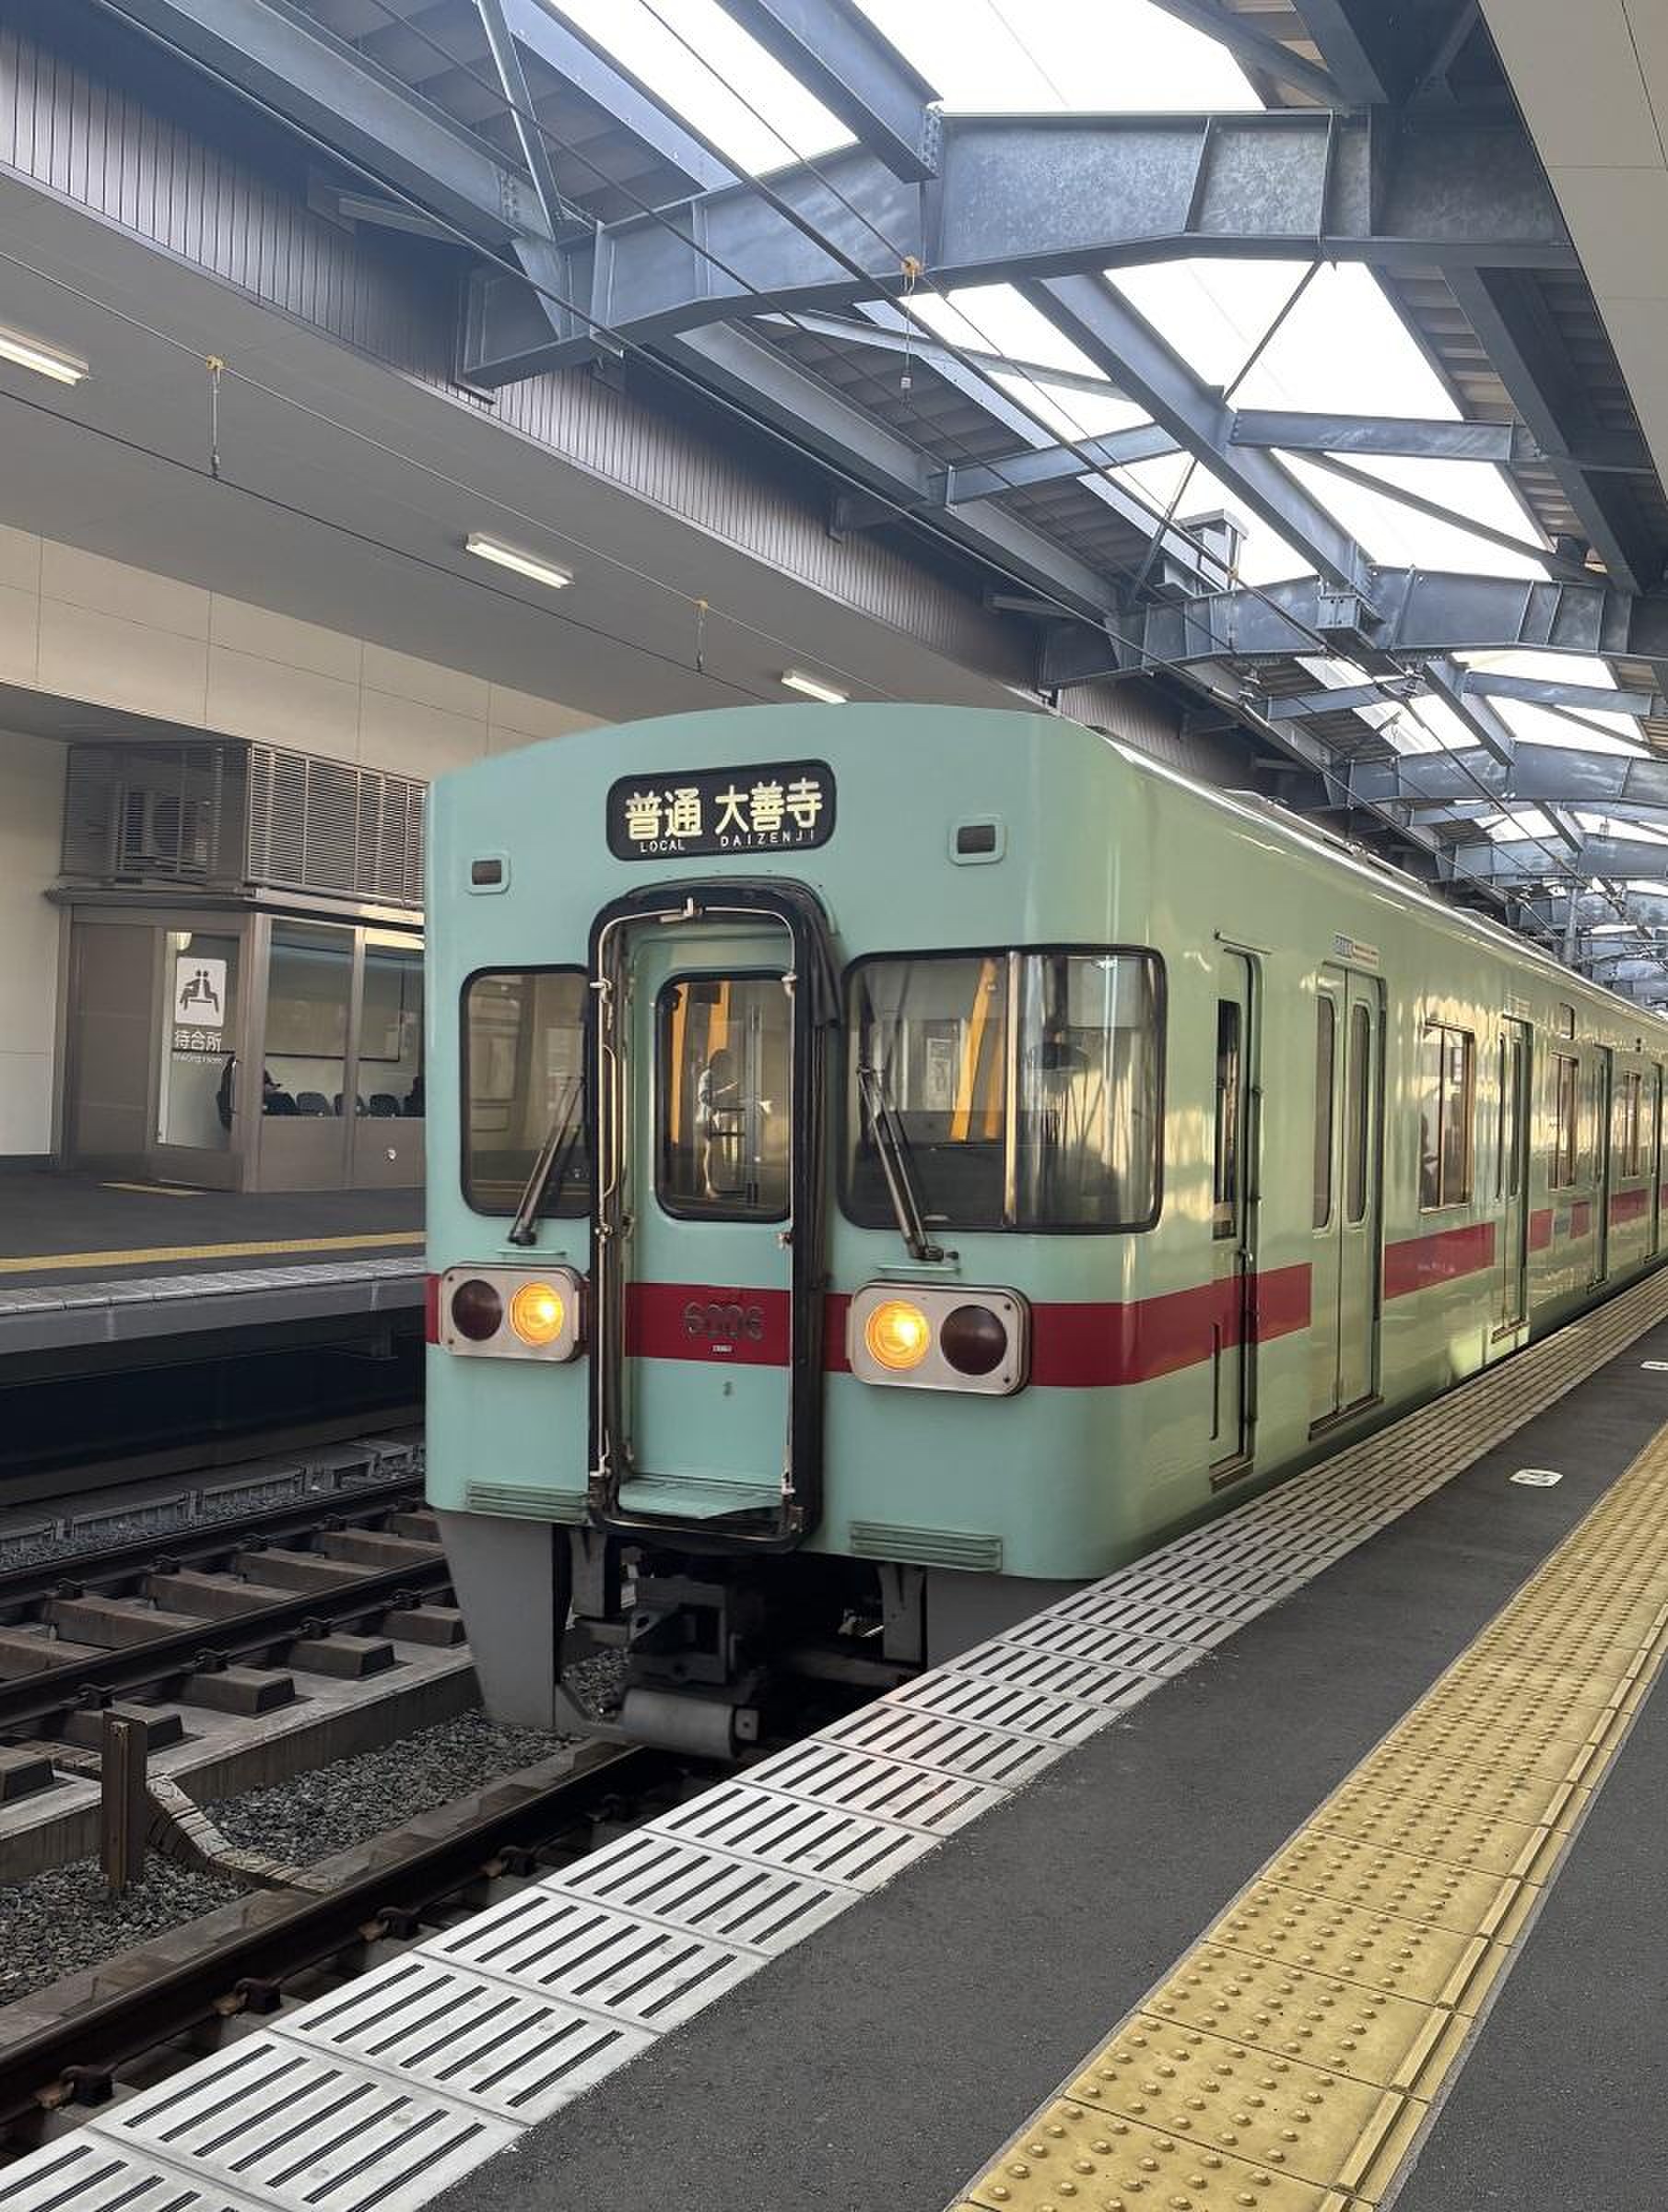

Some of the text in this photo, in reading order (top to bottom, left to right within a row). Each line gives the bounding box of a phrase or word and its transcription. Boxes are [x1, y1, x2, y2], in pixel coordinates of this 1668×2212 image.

[625, 777, 823, 841] 普通 大善寺
[640, 829, 816, 853] LOCAL DAIZENJI
[174, 1030, 222, 1053] 待合所
